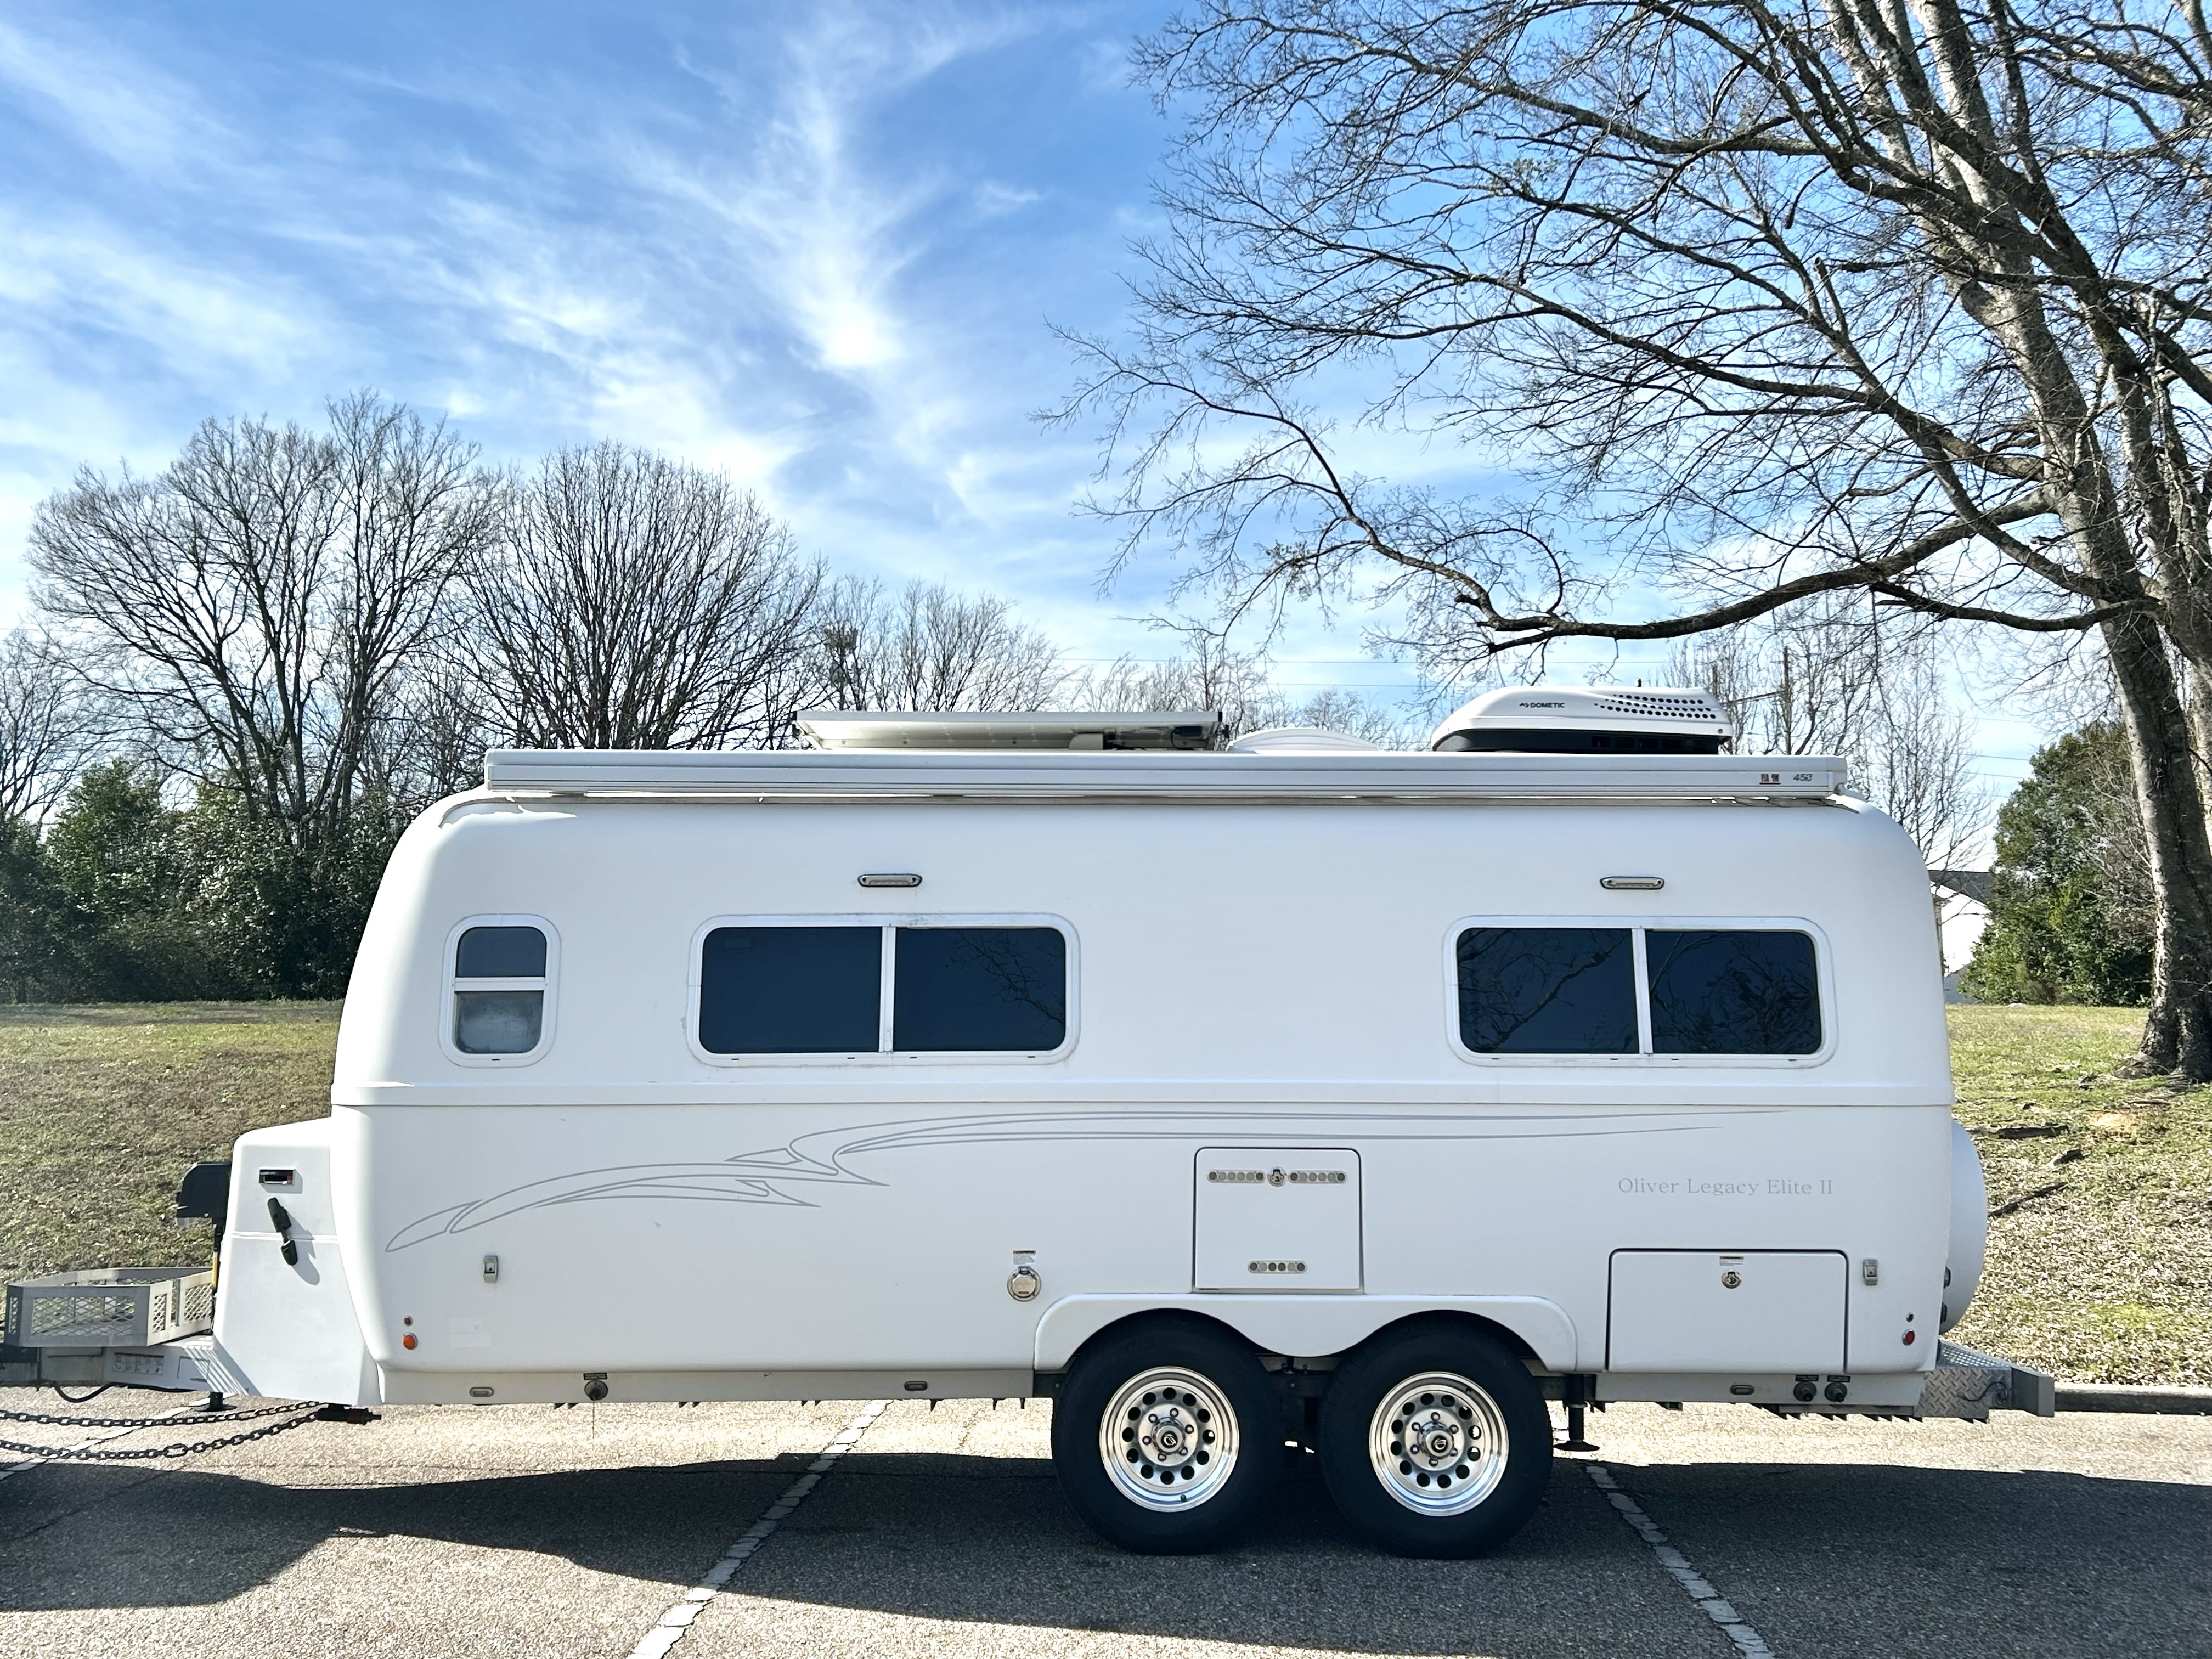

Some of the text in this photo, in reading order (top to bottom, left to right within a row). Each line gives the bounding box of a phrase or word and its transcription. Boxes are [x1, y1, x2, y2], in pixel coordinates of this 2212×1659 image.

[1618, 1177, 1833, 1196] Oliver Legacy Elite II
